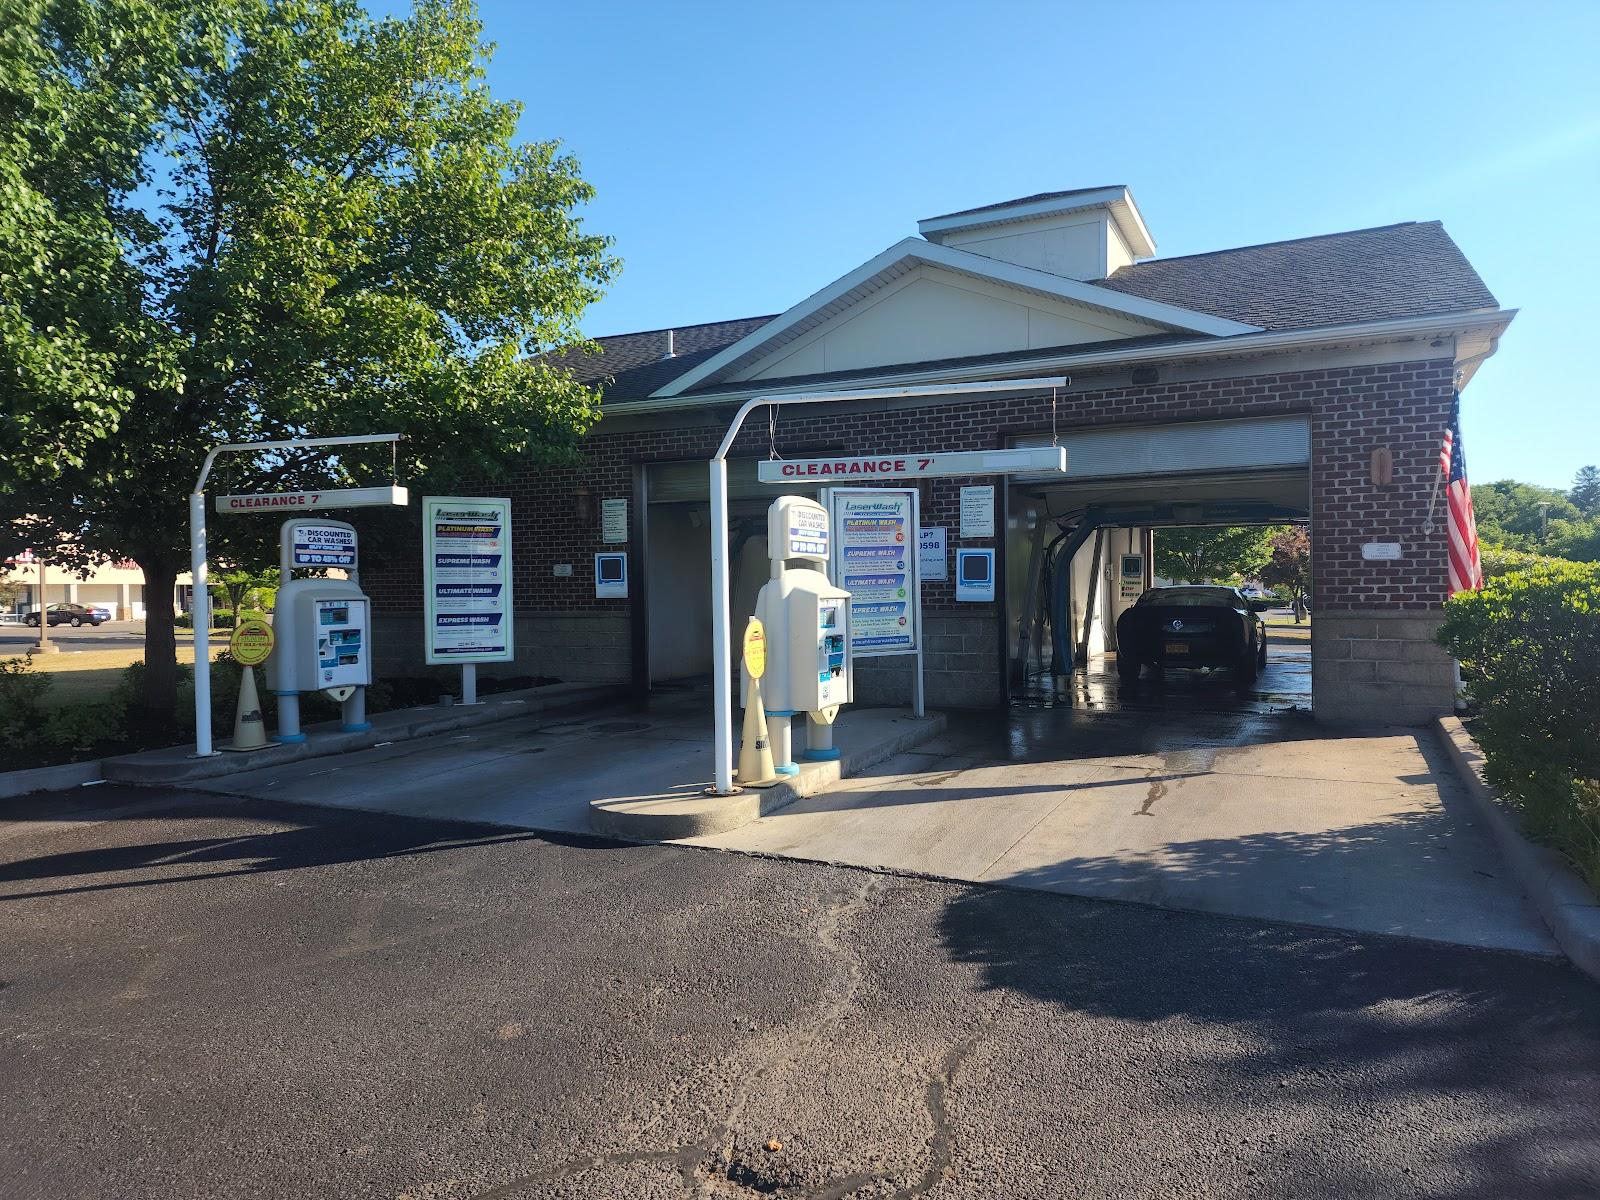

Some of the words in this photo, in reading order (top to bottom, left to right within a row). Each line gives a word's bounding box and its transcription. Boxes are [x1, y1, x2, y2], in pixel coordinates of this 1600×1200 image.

[781, 459, 906, 476] CLEARANCE
[917, 458, 935, 471] 7'
[230, 496, 305, 508] CLEARANCE
[312, 494, 322, 504] 7'
[308, 530, 352, 538] DISCOUNTED
